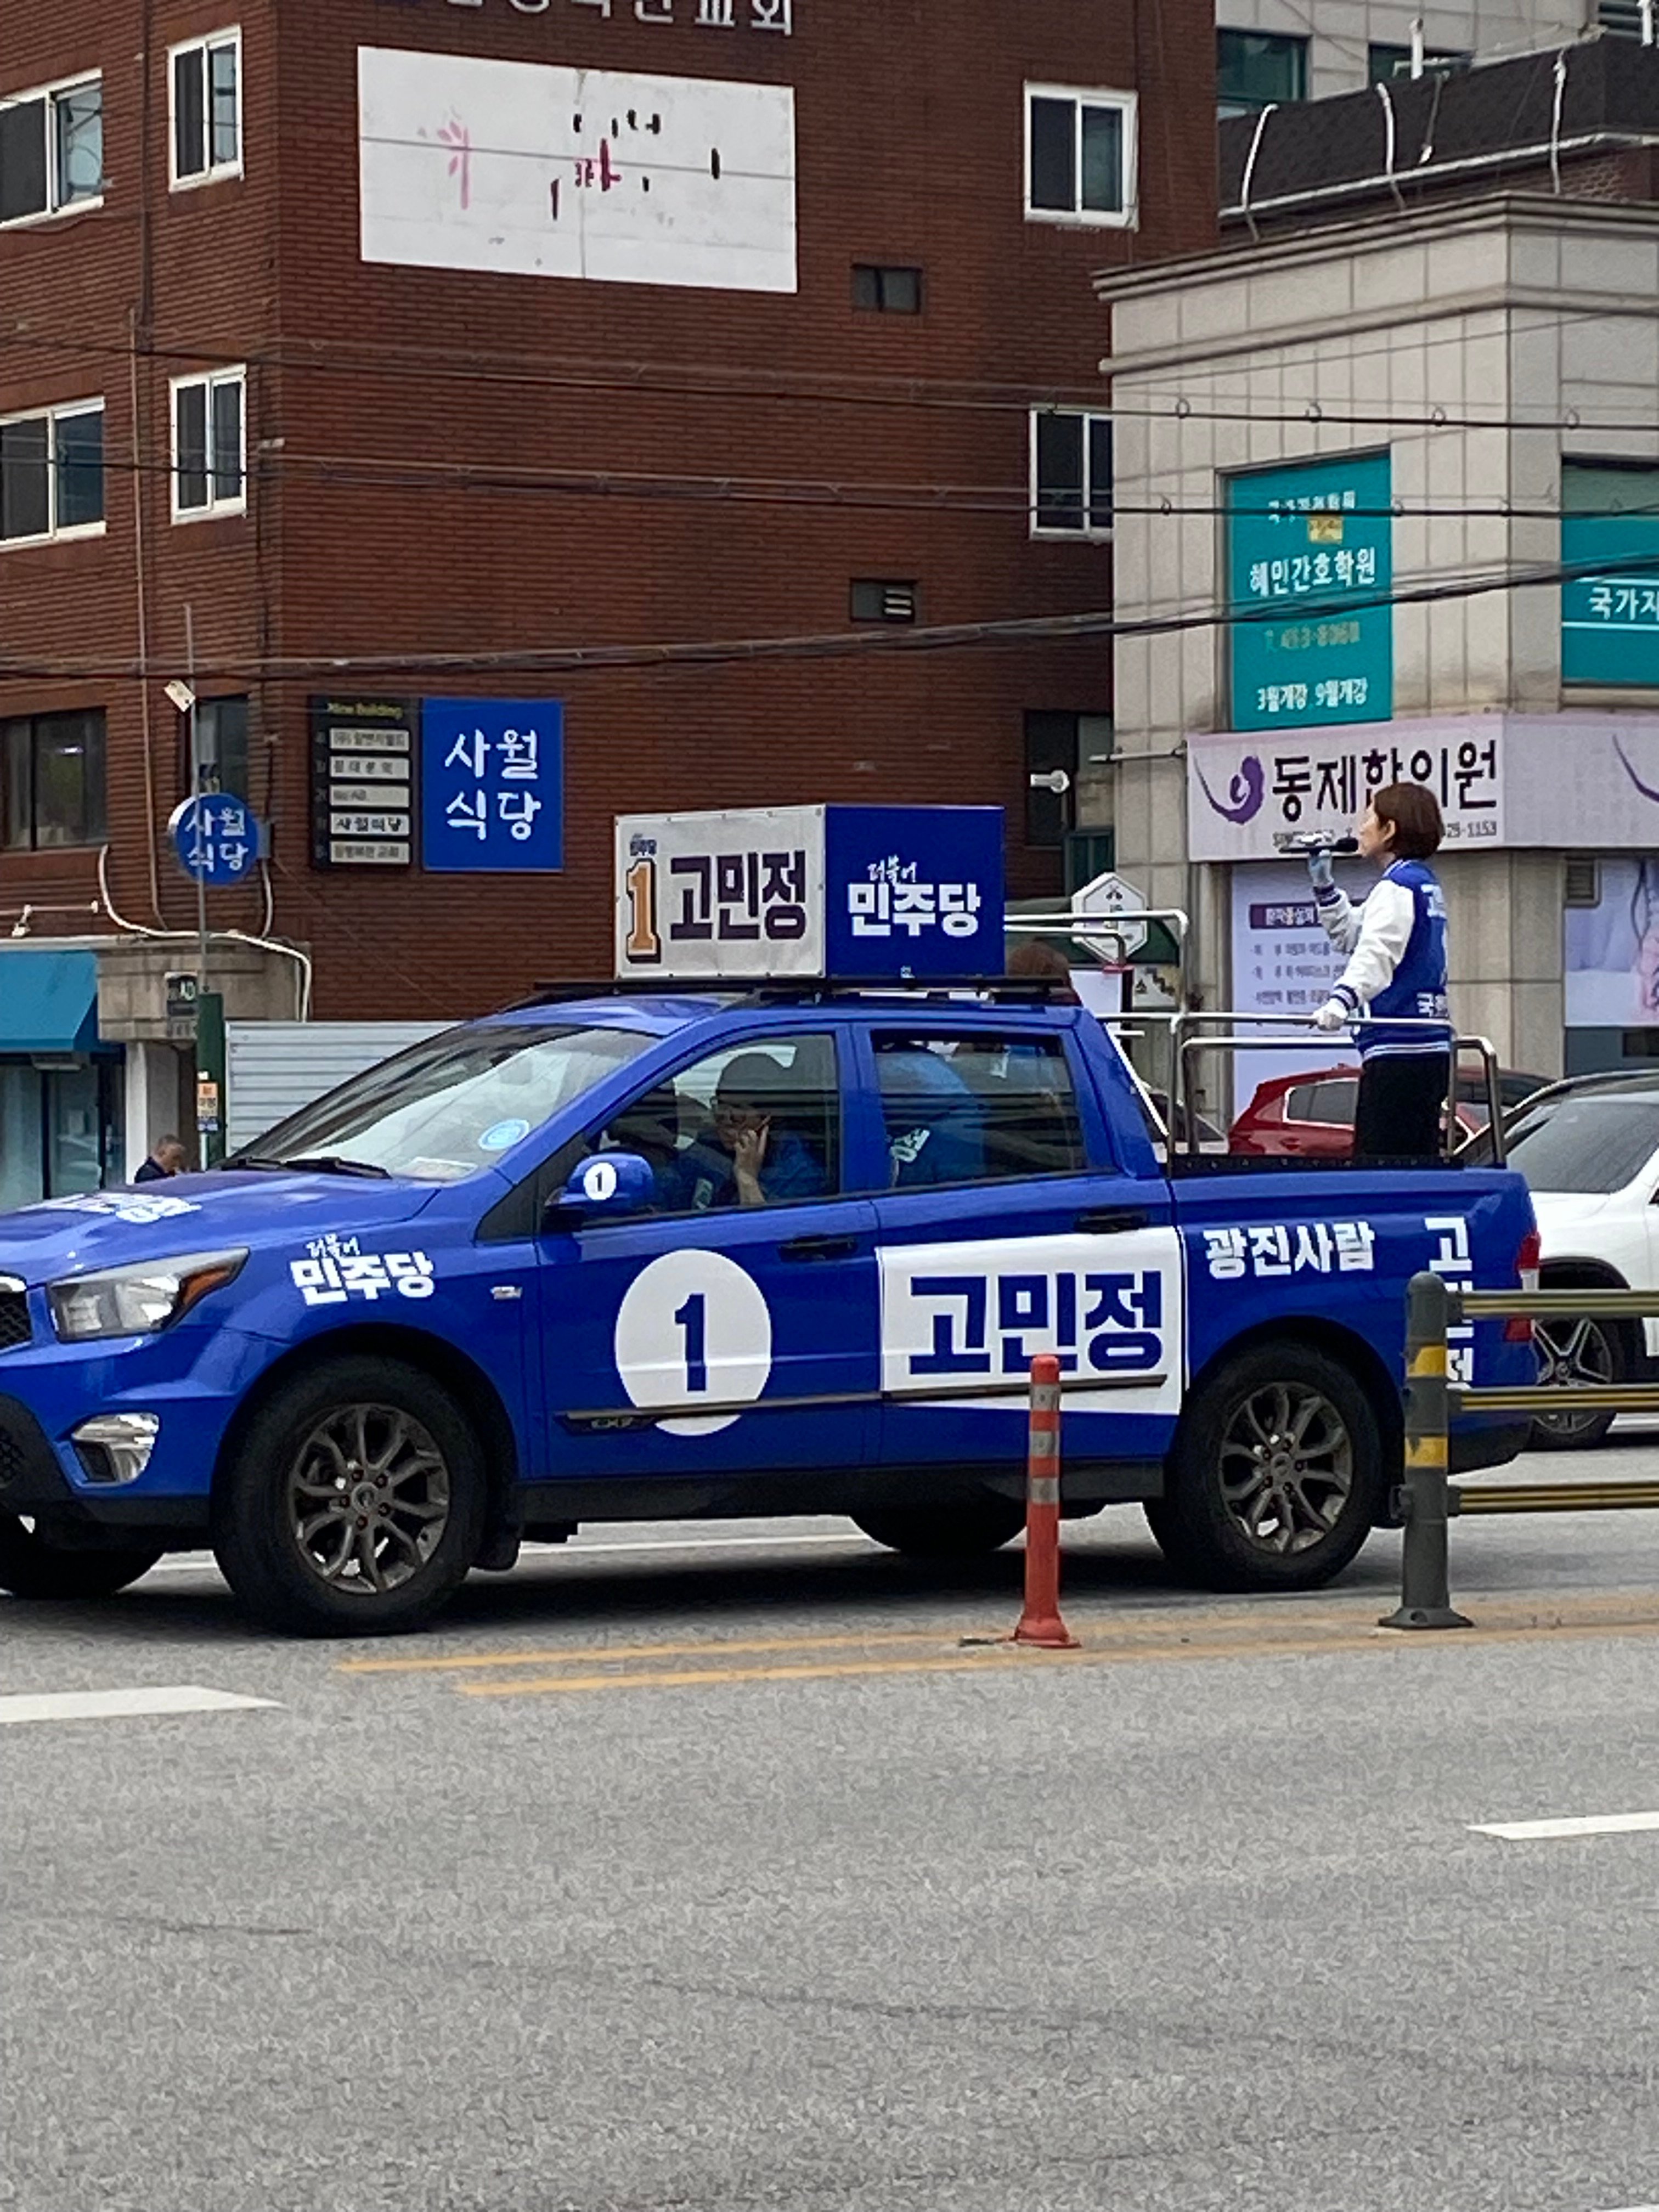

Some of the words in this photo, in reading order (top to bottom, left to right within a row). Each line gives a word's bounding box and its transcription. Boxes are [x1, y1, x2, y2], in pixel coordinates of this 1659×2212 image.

[445, 729, 539, 780] 사월
[185, 807, 246, 837] 사월
[446, 789, 541, 840] 식당
[187, 842, 249, 872] 식당
[626, 858, 661, 963] 1
[670, 850, 806, 940] 고민정
[847, 882, 981, 937] 민주당
[595, 1171, 603, 1192] 1
[1204, 1221, 1375, 1279] 광진사람
[290, 1251, 434, 1306] 민주당
[674, 1293, 707, 1392] 1
[909, 1270, 1162, 1375] 고민정
